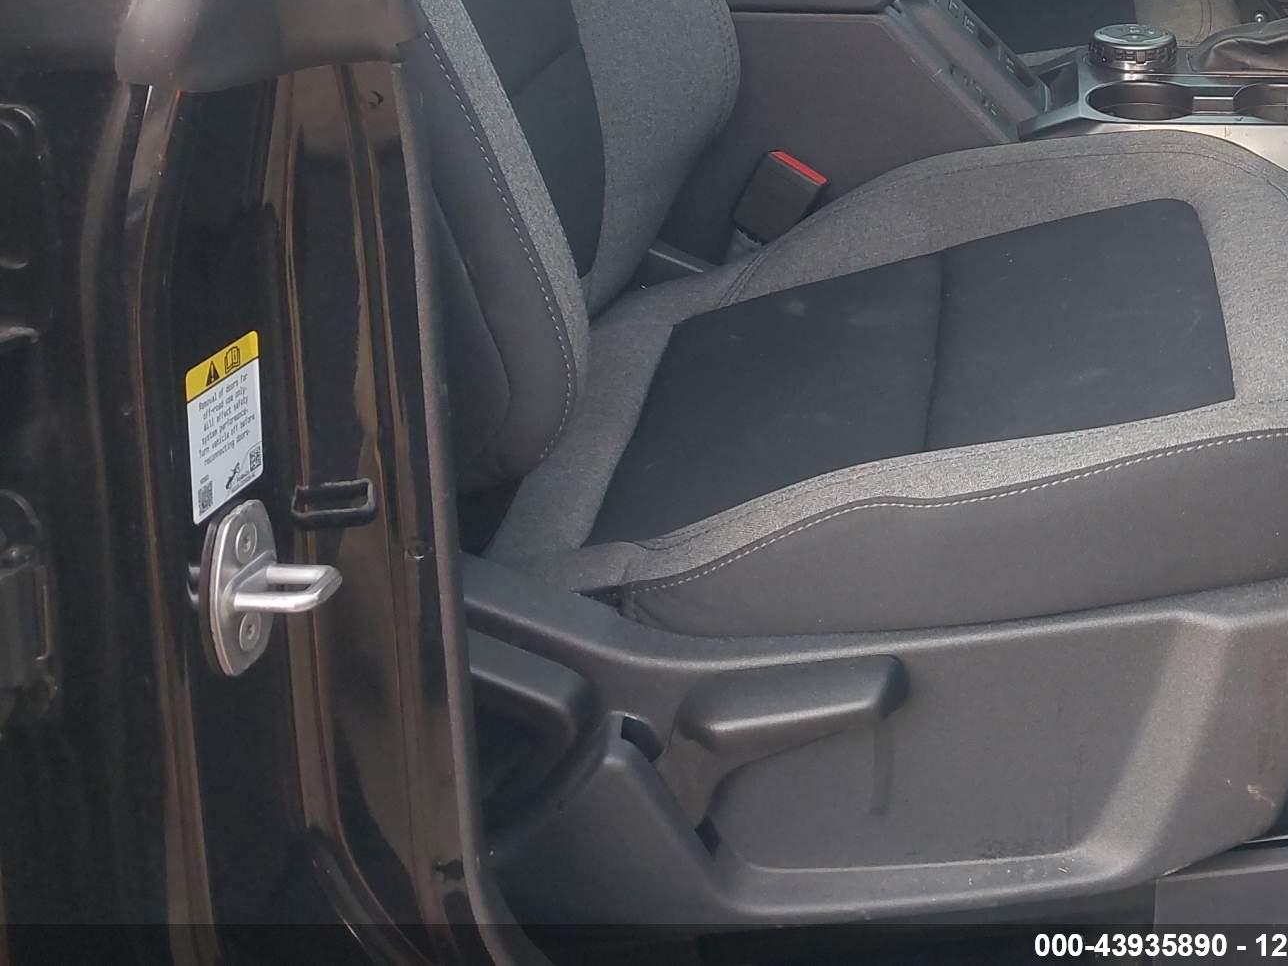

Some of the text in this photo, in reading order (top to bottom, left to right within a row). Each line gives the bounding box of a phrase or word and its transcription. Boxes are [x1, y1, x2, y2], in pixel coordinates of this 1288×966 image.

[198, 391, 217, 410] Removal
[226, 380, 239, 393] doors
[216, 407, 232, 423] affect
[233, 395, 249, 410] safety
[198, 446, 210, 459] Turn
[211, 431, 229, 449] vehicle
[240, 413, 256, 429] before
[201, 429, 218, 445] system
